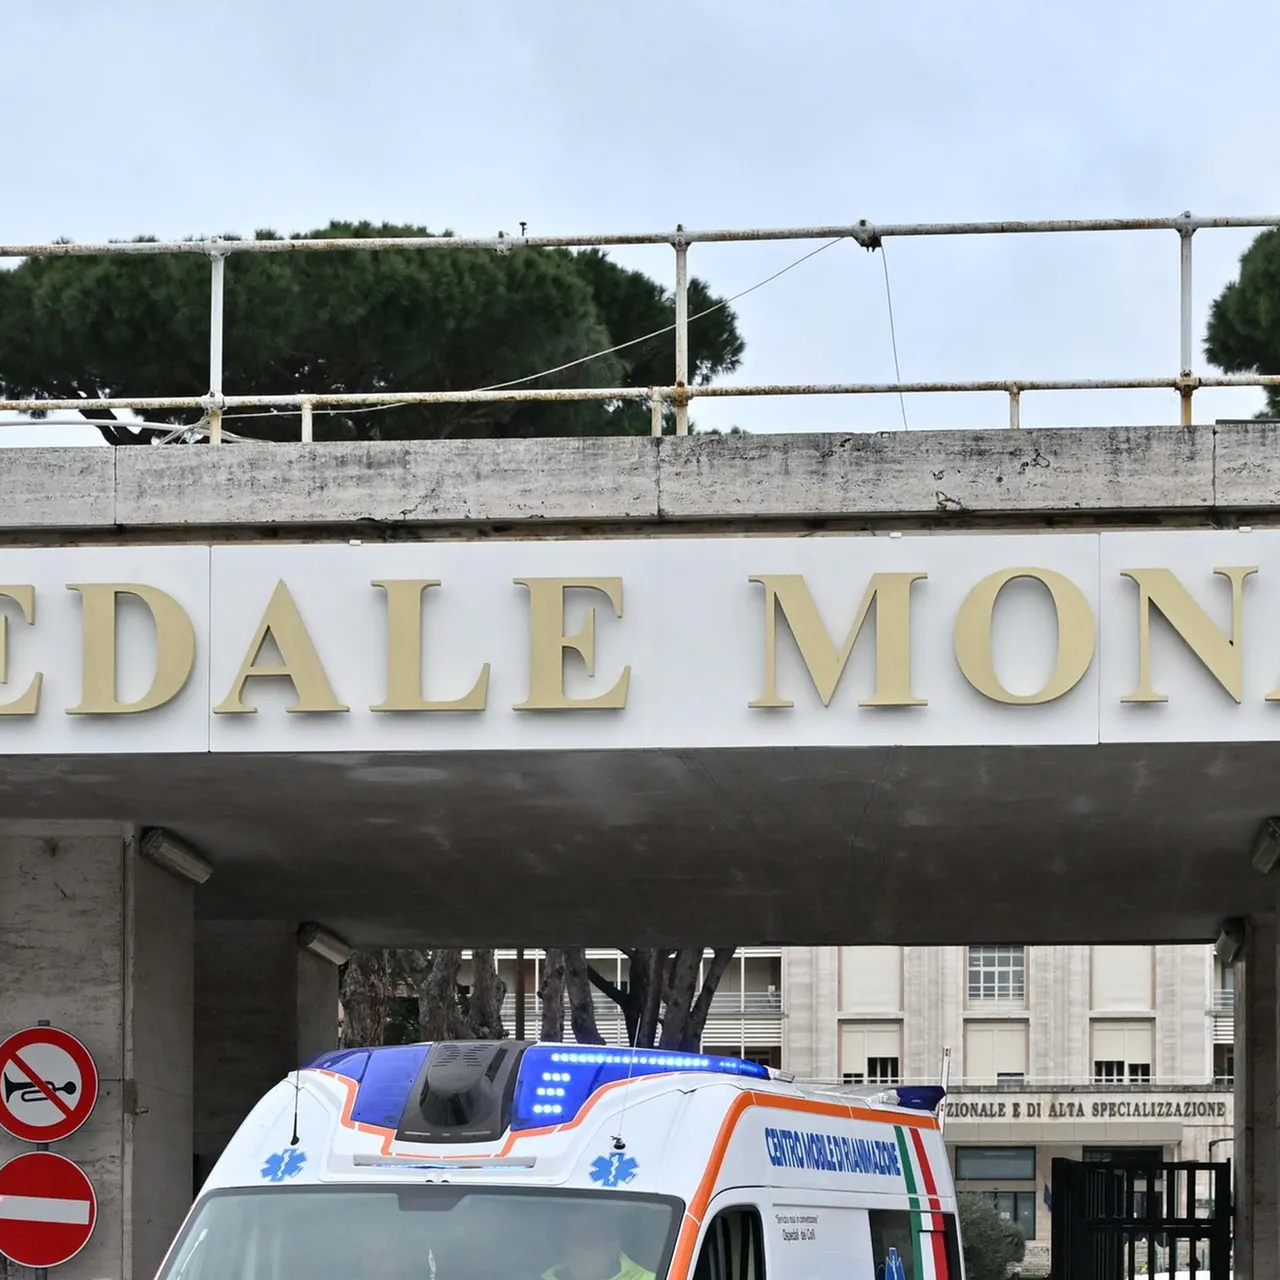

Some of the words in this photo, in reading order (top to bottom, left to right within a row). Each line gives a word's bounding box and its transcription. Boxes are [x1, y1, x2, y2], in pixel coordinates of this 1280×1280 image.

[946, 1103, 1006, 1118] ZIONALE
[1012, 1103, 1020, 1118] E
[1026, 1103, 1041, 1118] DI
[1048, 1102, 1085, 1118] ALTA
[1091, 1101, 1227, 1118] SPECIALIZZAZIONE
[764, 1127, 804, 1169] CENTRO
[801, 1131, 836, 1171] MOBILE
